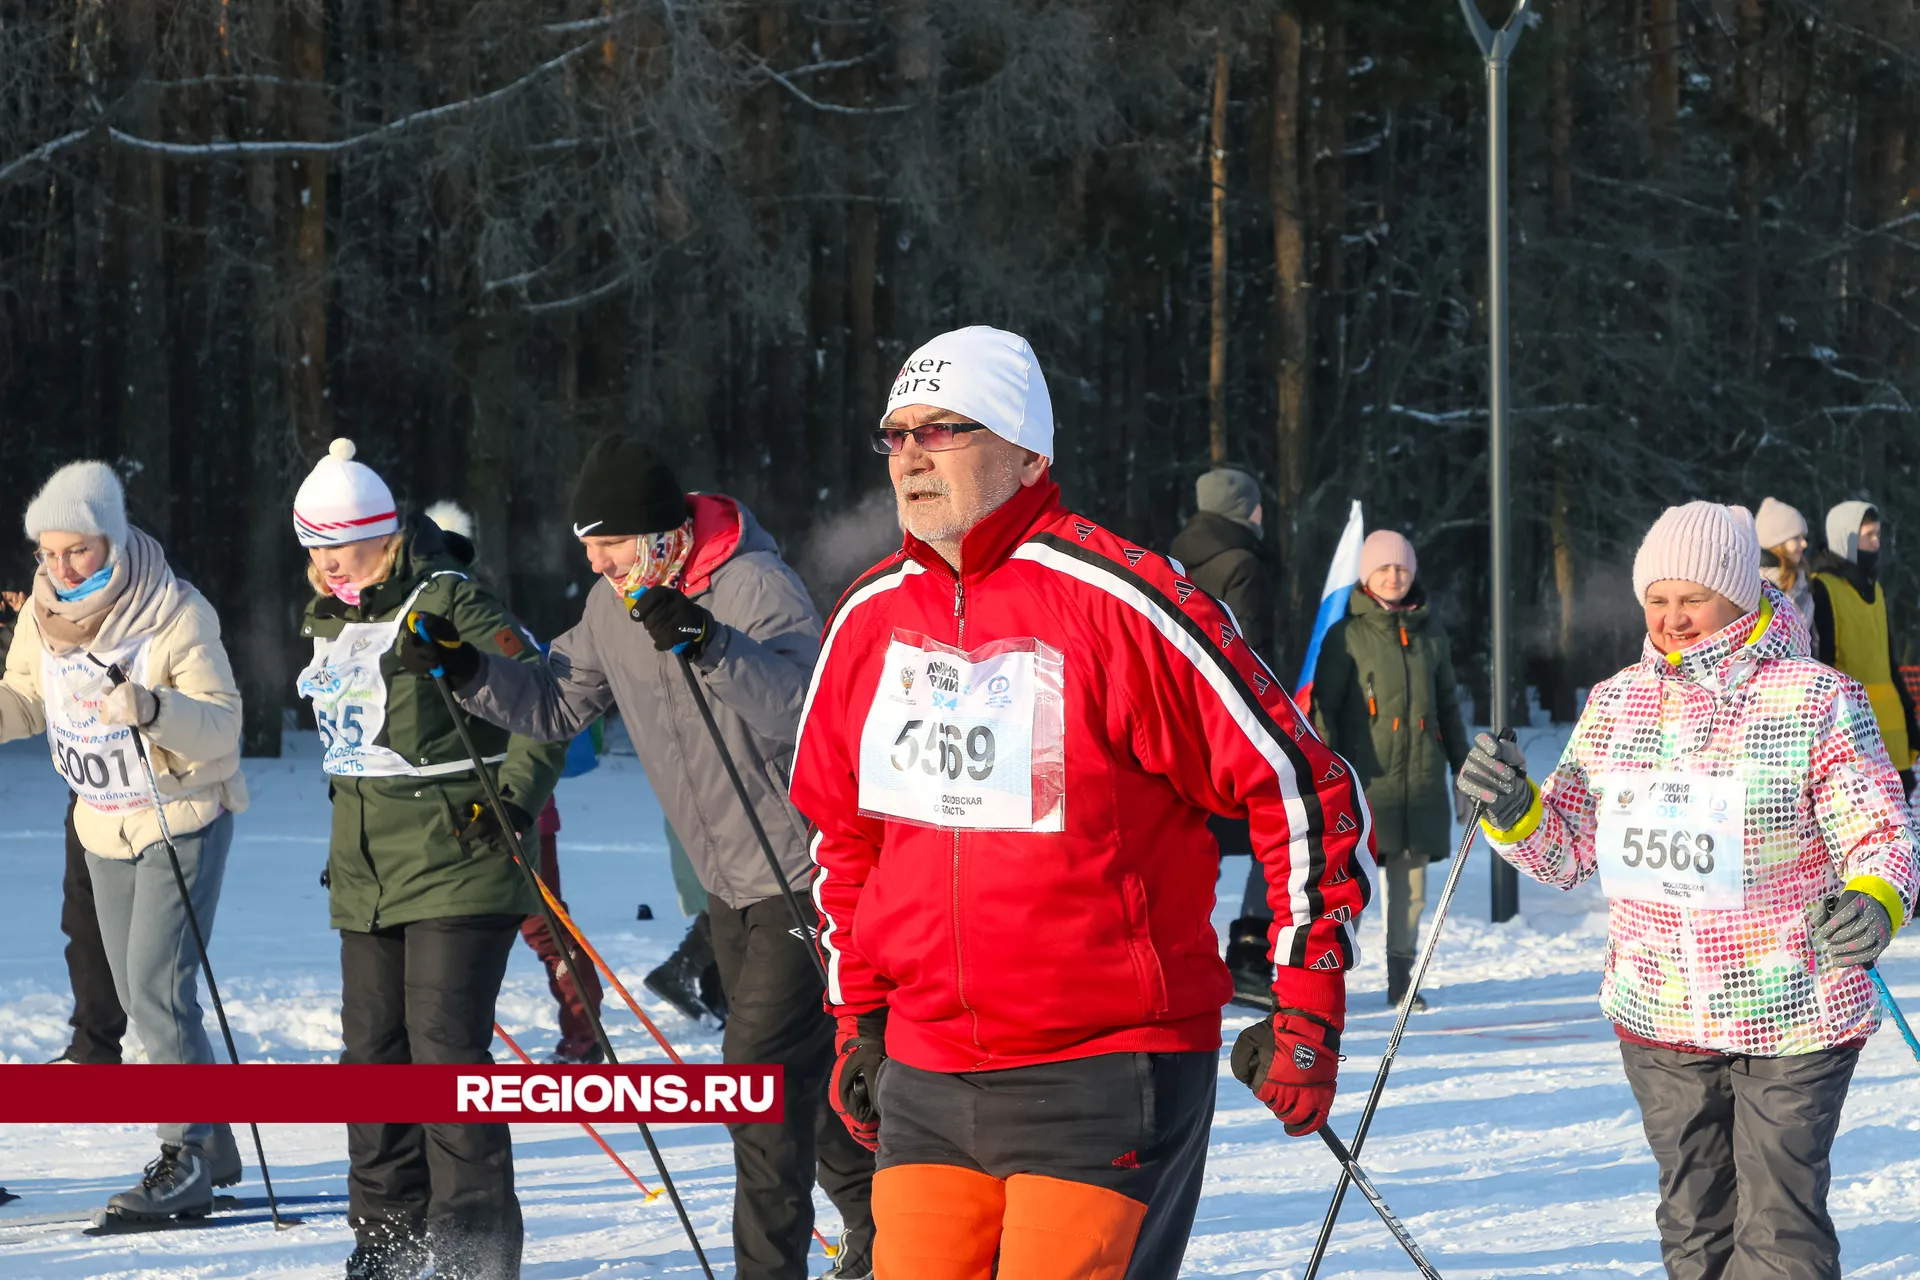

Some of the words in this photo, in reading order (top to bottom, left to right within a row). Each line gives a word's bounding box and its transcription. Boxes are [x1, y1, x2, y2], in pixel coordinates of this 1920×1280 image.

[57, 738, 130, 789] 5001
[891, 719, 996, 781] 5569
[1622, 827, 1715, 874] 5568
[1662, 881, 1705, 893] МОСКОВСКАЯ
[1664, 888, 1691, 899] ОБЛАСТЬ
